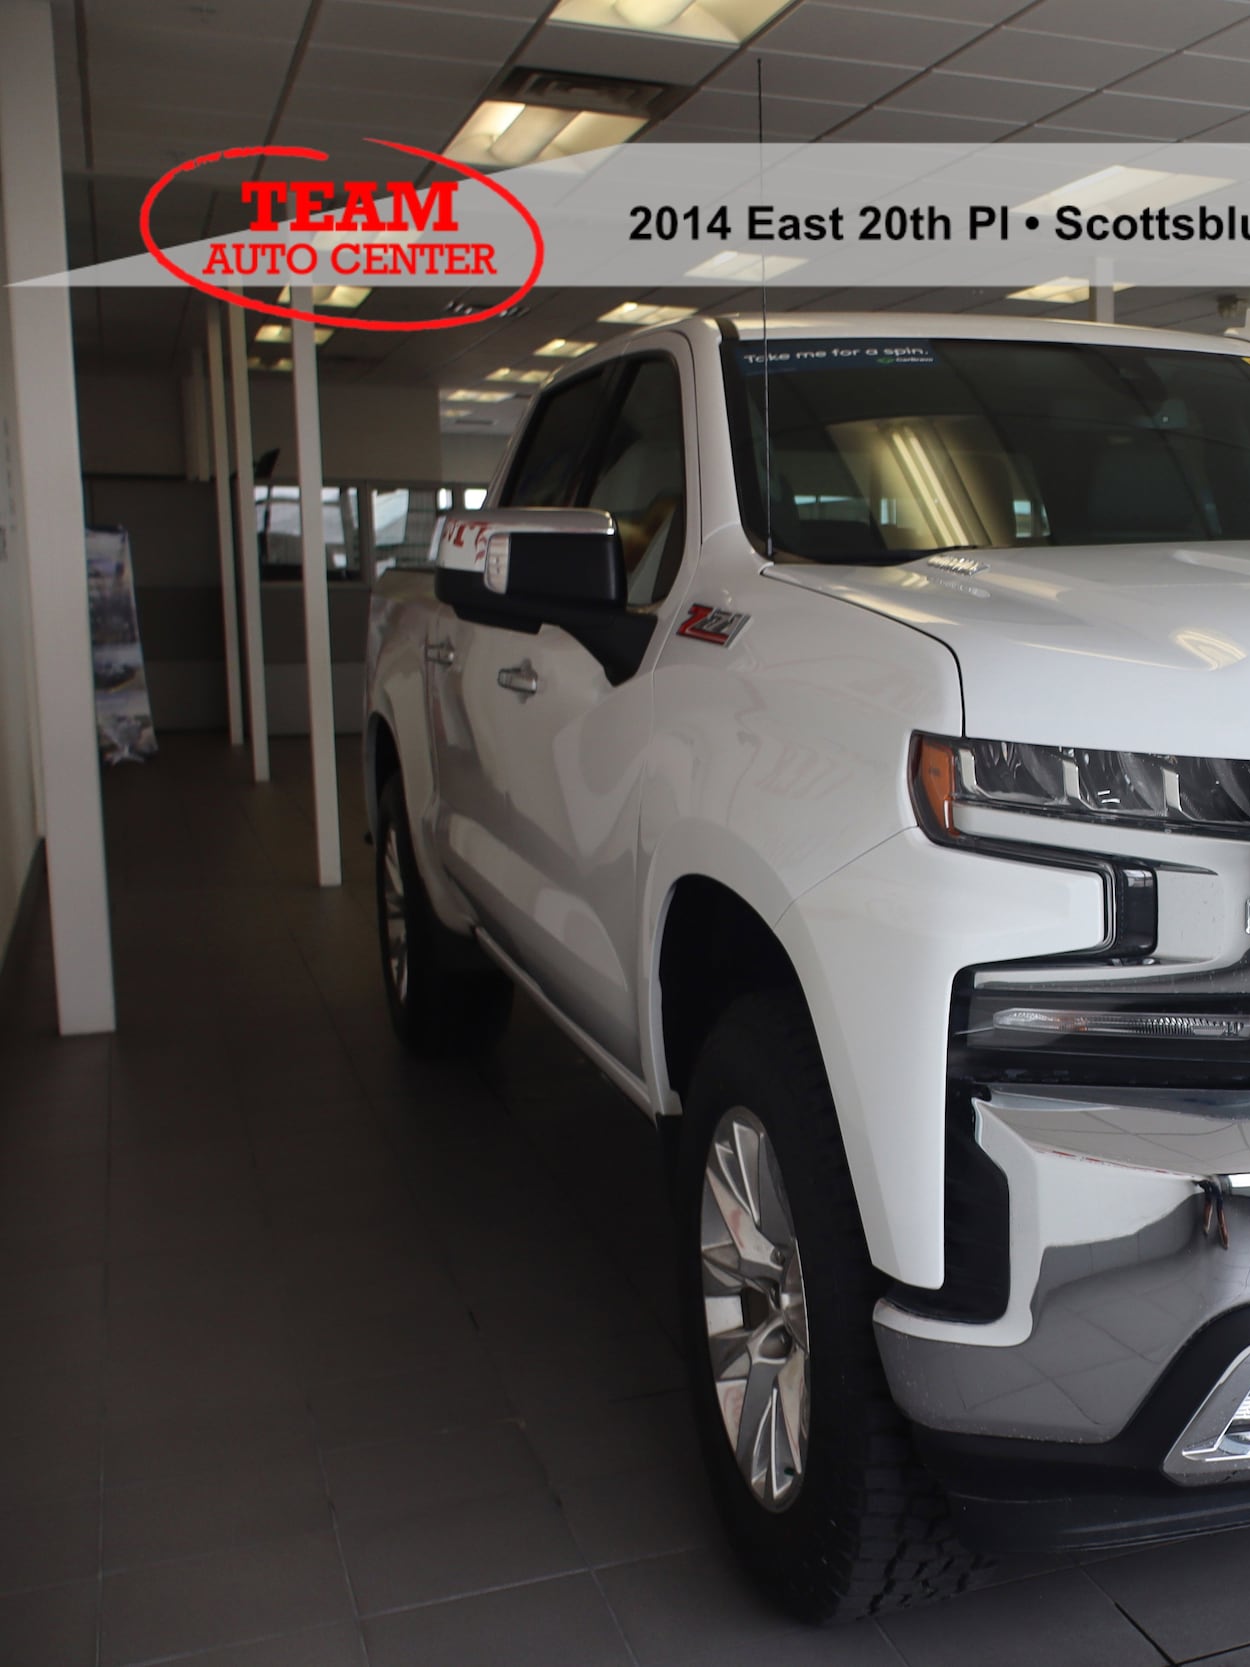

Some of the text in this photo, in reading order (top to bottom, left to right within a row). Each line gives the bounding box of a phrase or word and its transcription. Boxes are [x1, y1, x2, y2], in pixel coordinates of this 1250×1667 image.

[744, 346, 929, 363] Take me for a spin.
